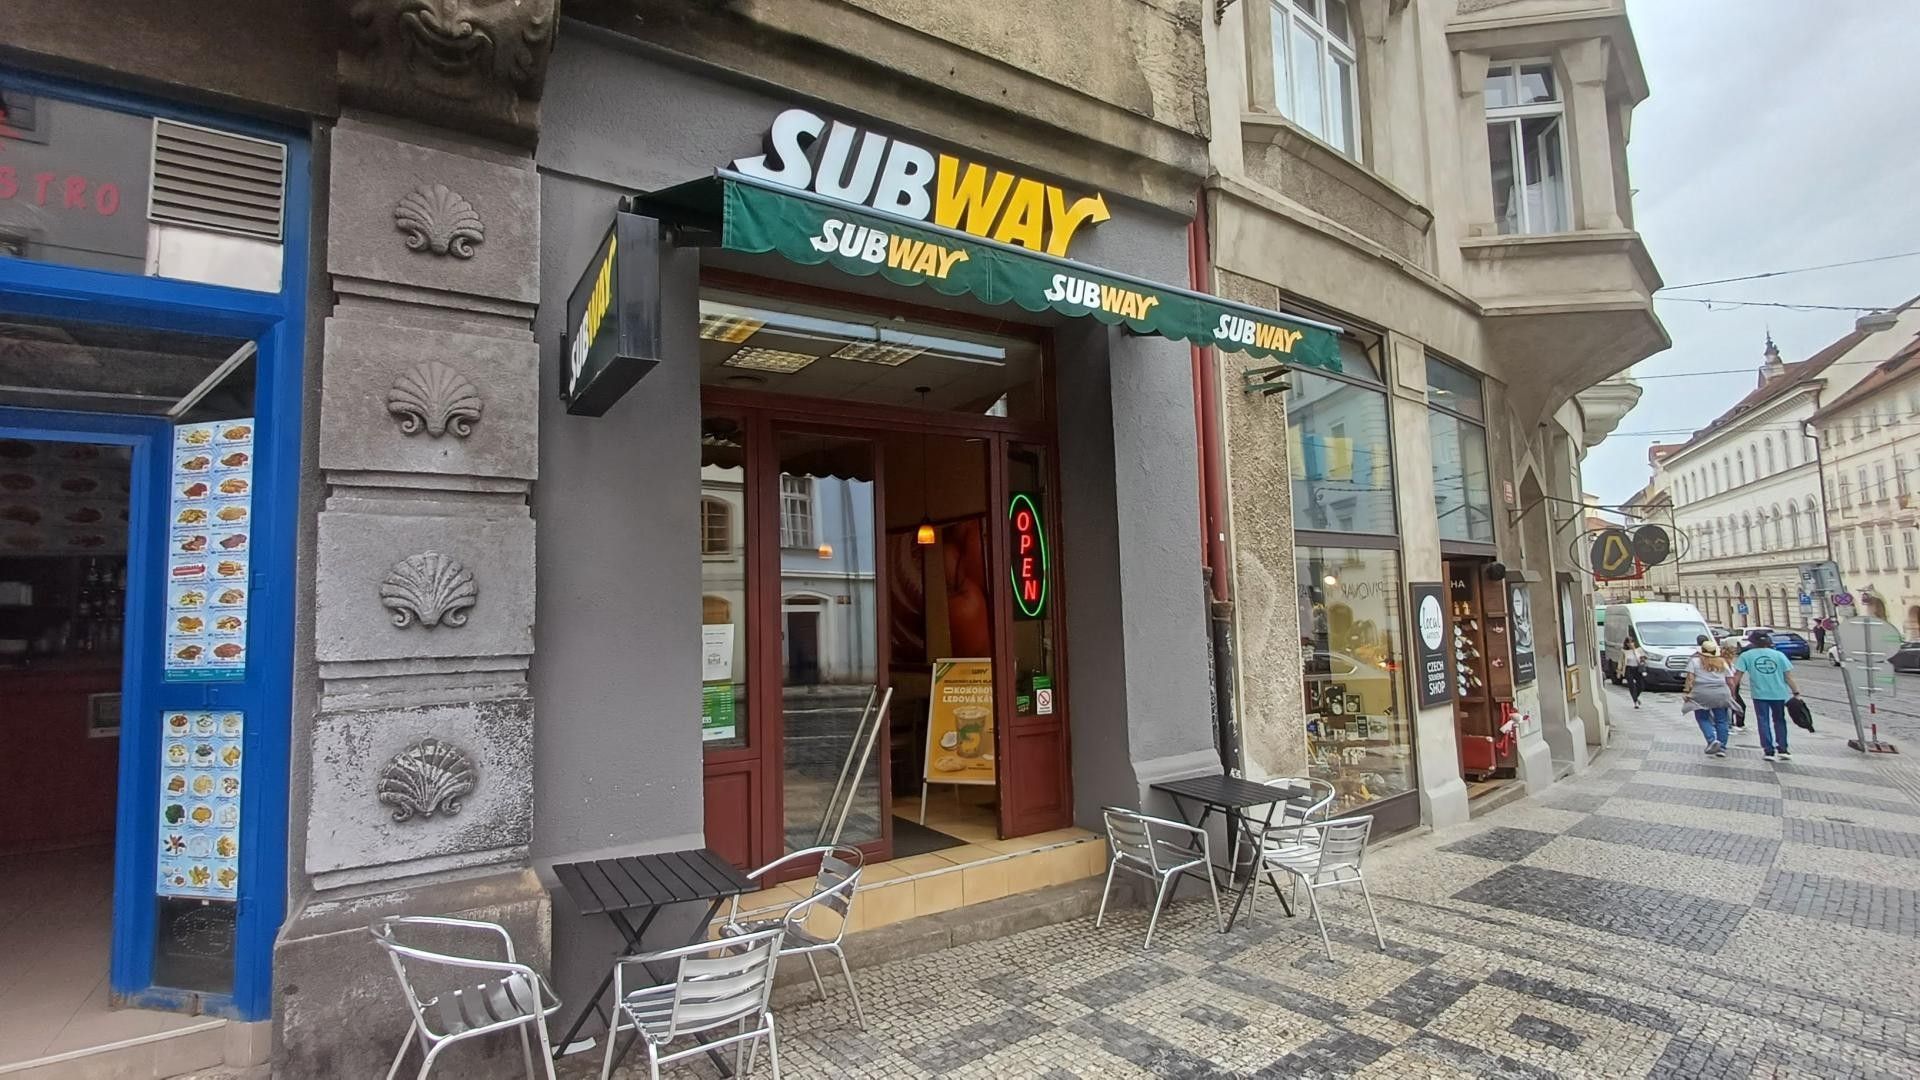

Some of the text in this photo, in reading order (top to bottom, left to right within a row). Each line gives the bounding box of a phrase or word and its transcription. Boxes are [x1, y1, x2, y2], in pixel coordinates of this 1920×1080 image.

[733, 109, 1111, 258] SUBWAY
[809, 218, 970, 279] SUBWAY
[568, 233, 617, 397] SUBWAY
[1043, 273, 1160, 321] SUBWAY
[1212, 313, 1303, 354] SUBWAY
[1016, 511, 1037, 600] OPEN
[1427, 660, 1444, 673] CZECH
[1429, 681, 1446, 696] SHOP
